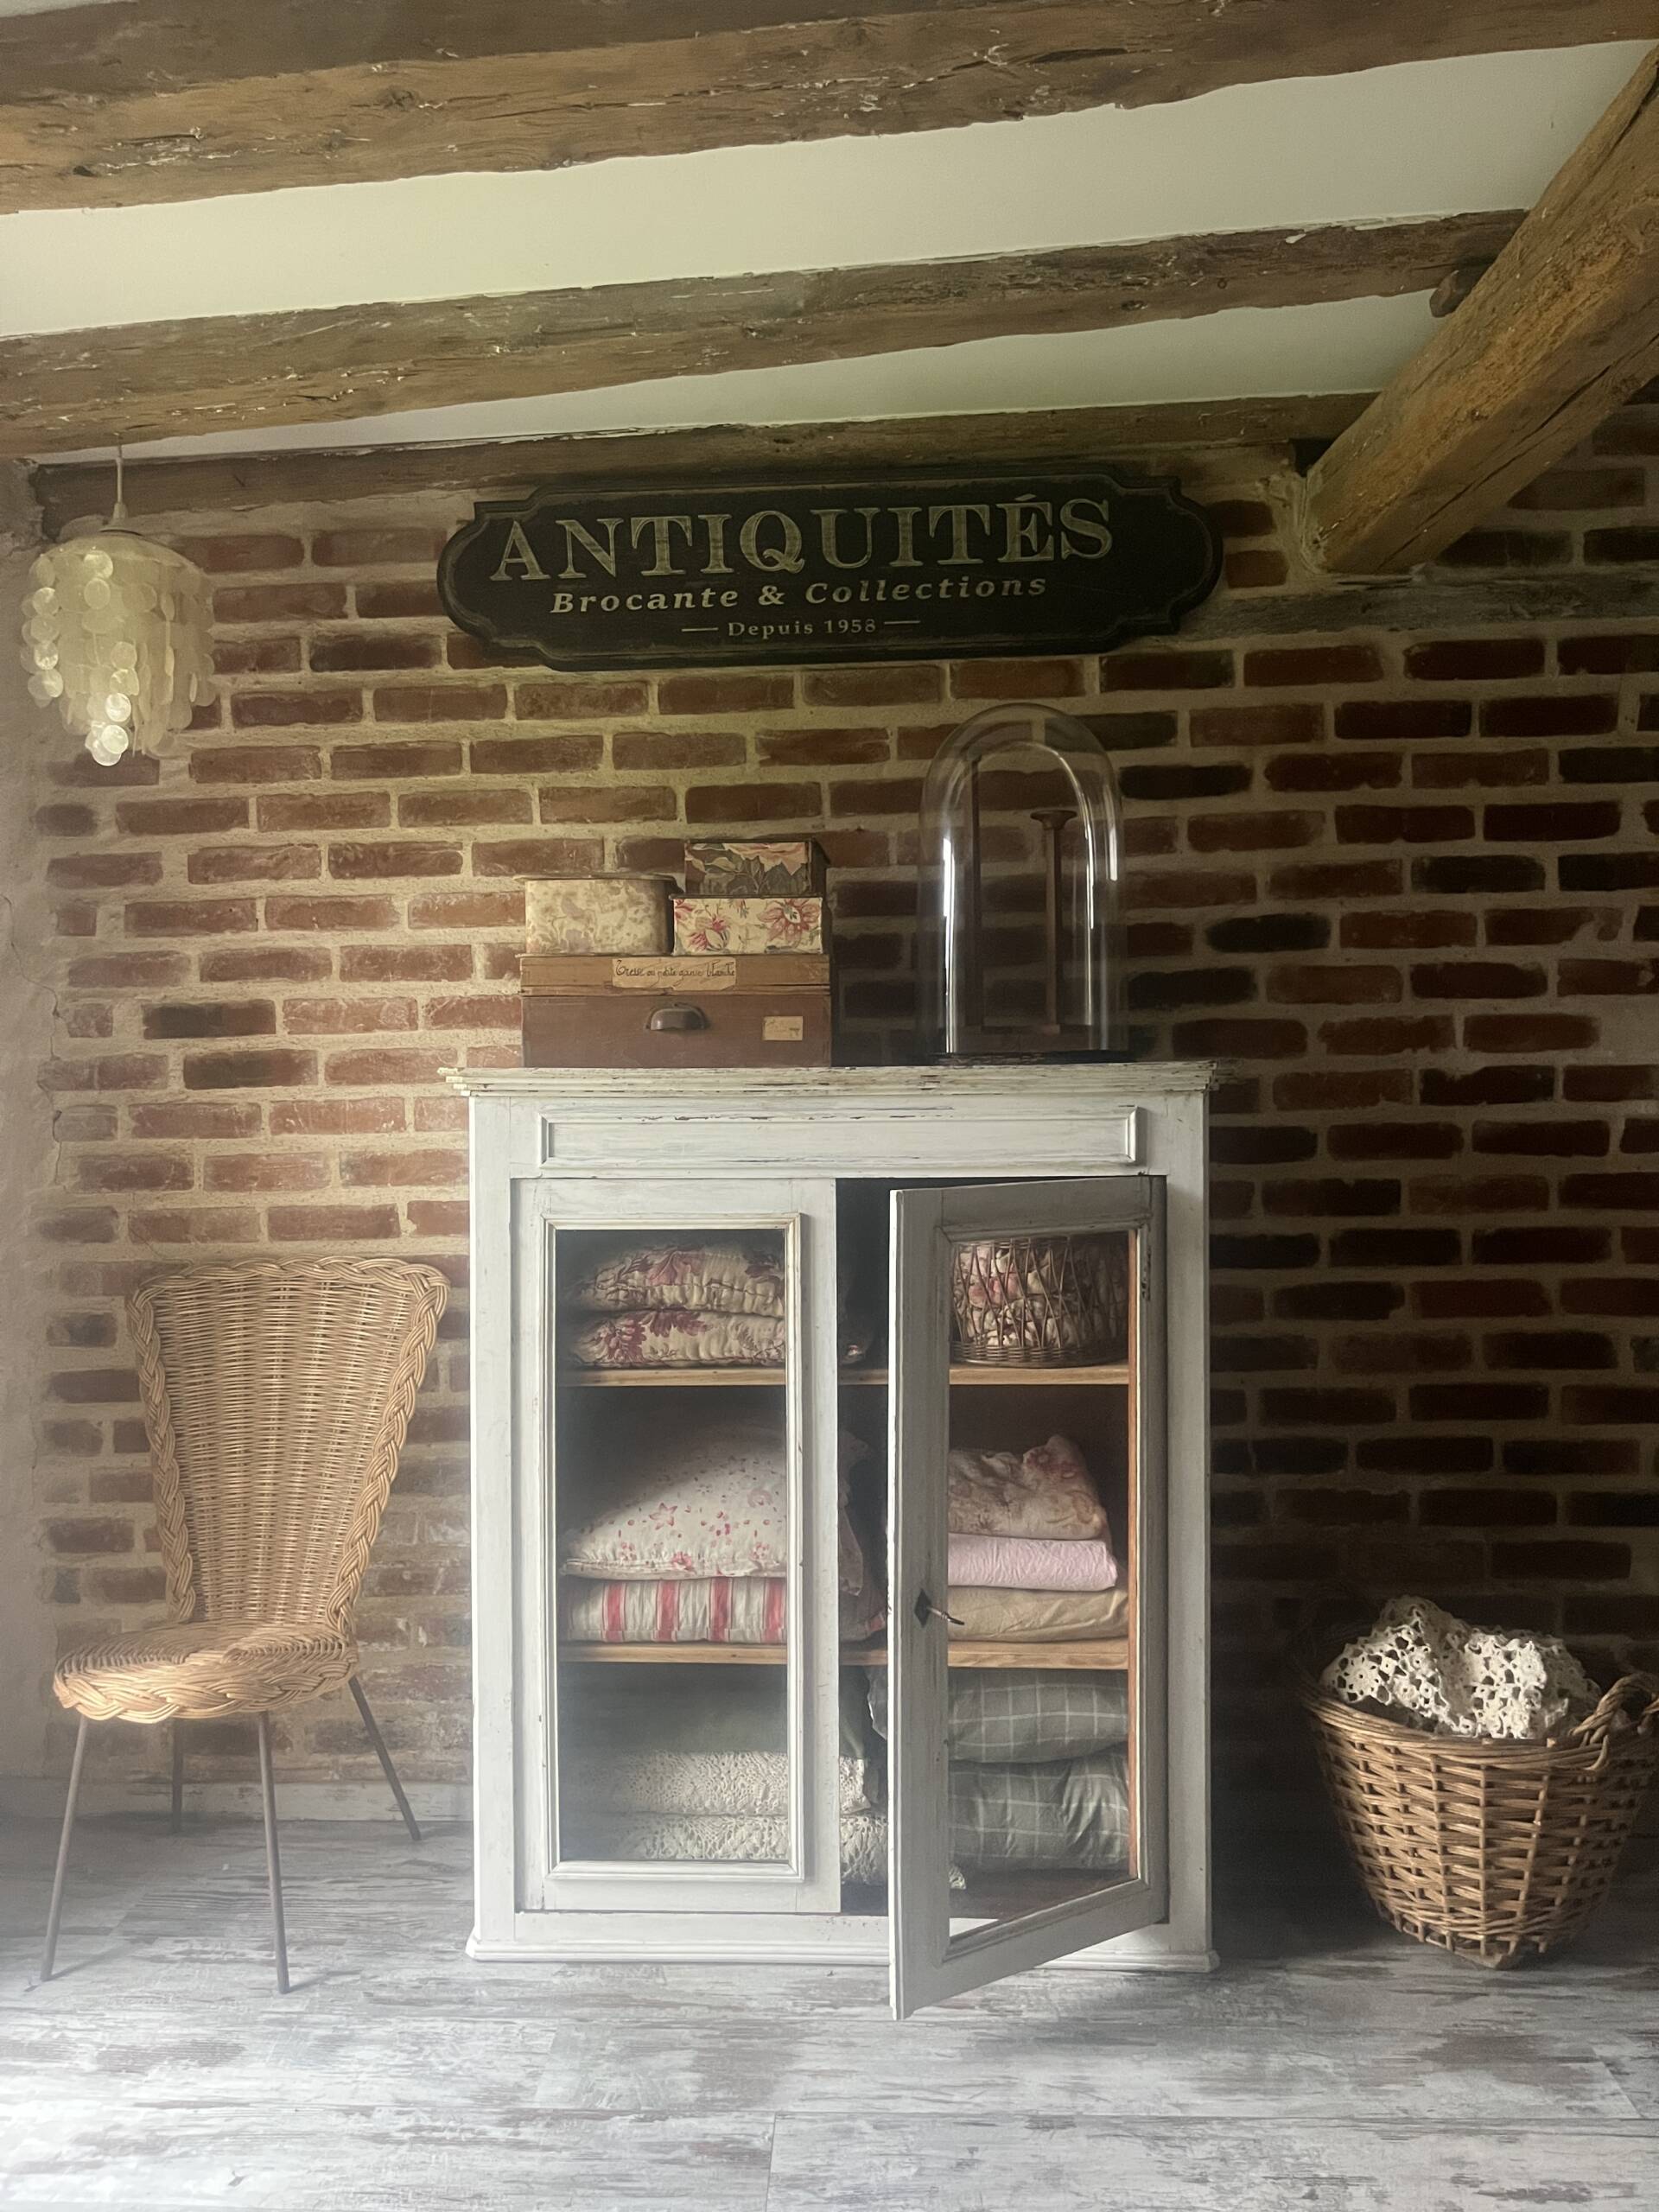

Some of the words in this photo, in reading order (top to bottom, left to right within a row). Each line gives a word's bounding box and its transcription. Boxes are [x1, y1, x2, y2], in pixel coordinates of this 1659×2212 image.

[489, 493, 1114, 582] ANTIQUITÉS
[550, 588, 739, 614] Brocante
[758, 584, 785, 606] &
[804, 576, 1047, 605] Collections
[728, 620, 814, 639] Depuis
[823, 619, 877, 634] 1958
